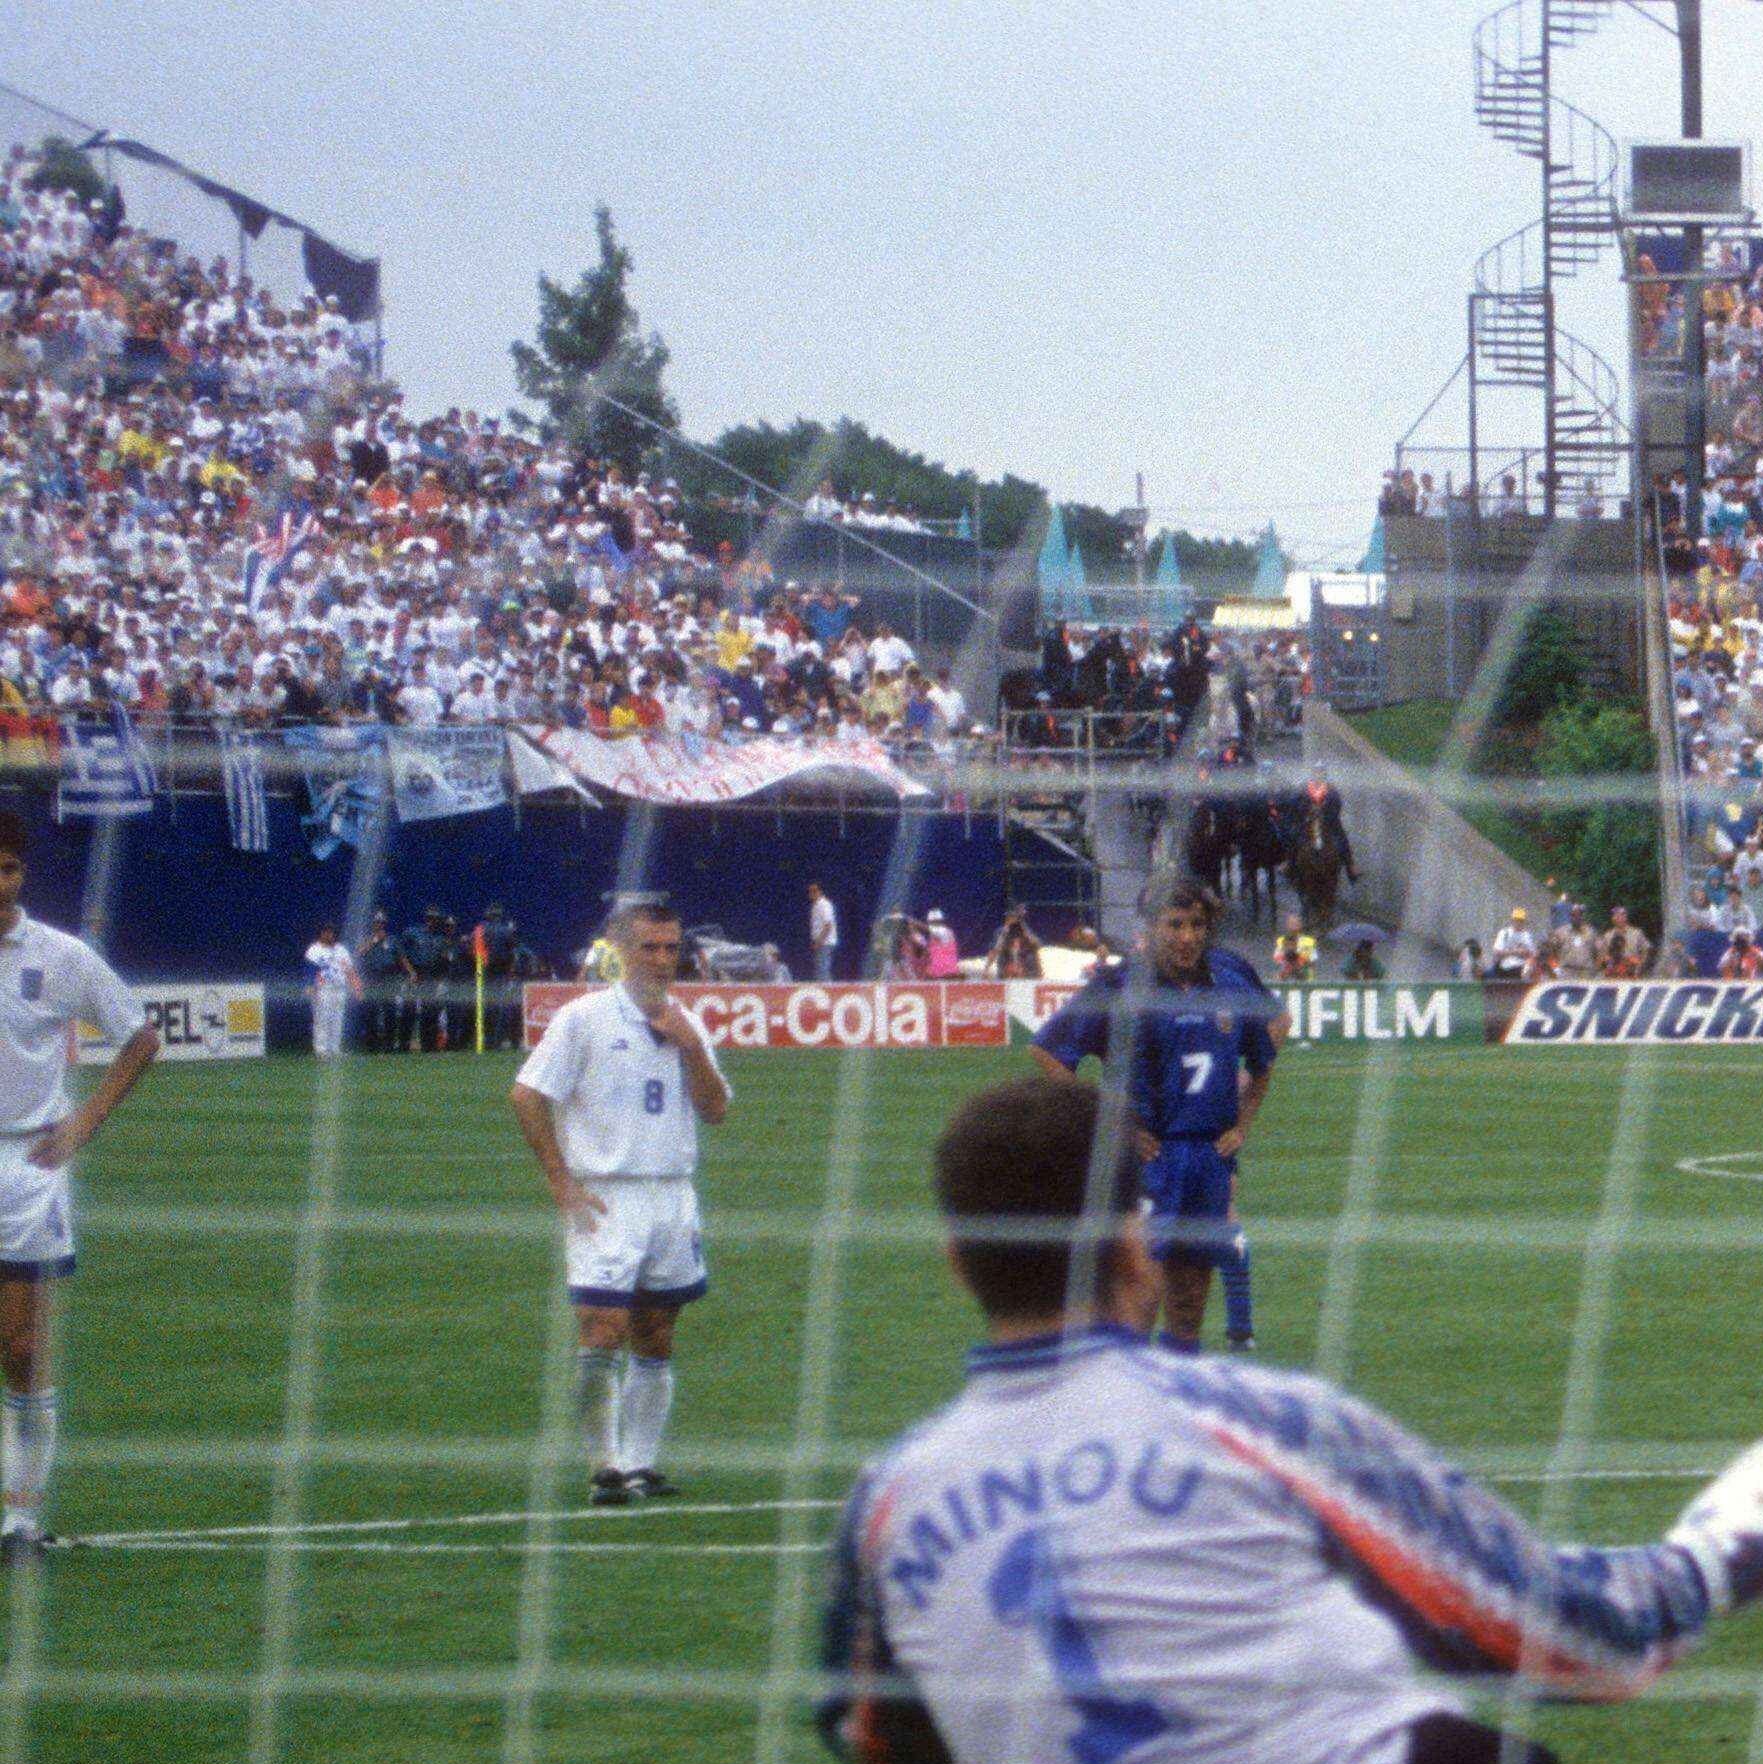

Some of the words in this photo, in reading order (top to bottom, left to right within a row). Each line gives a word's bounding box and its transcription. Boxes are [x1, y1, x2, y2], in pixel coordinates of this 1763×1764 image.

[145, 999, 202, 1045] PEL
[691, 987, 928, 1044] ca-Cola
[644, 1078, 664, 1115] 8
[1181, 1052, 1214, 1095] 7
[885, 1440, 1200, 1608] MINOU
